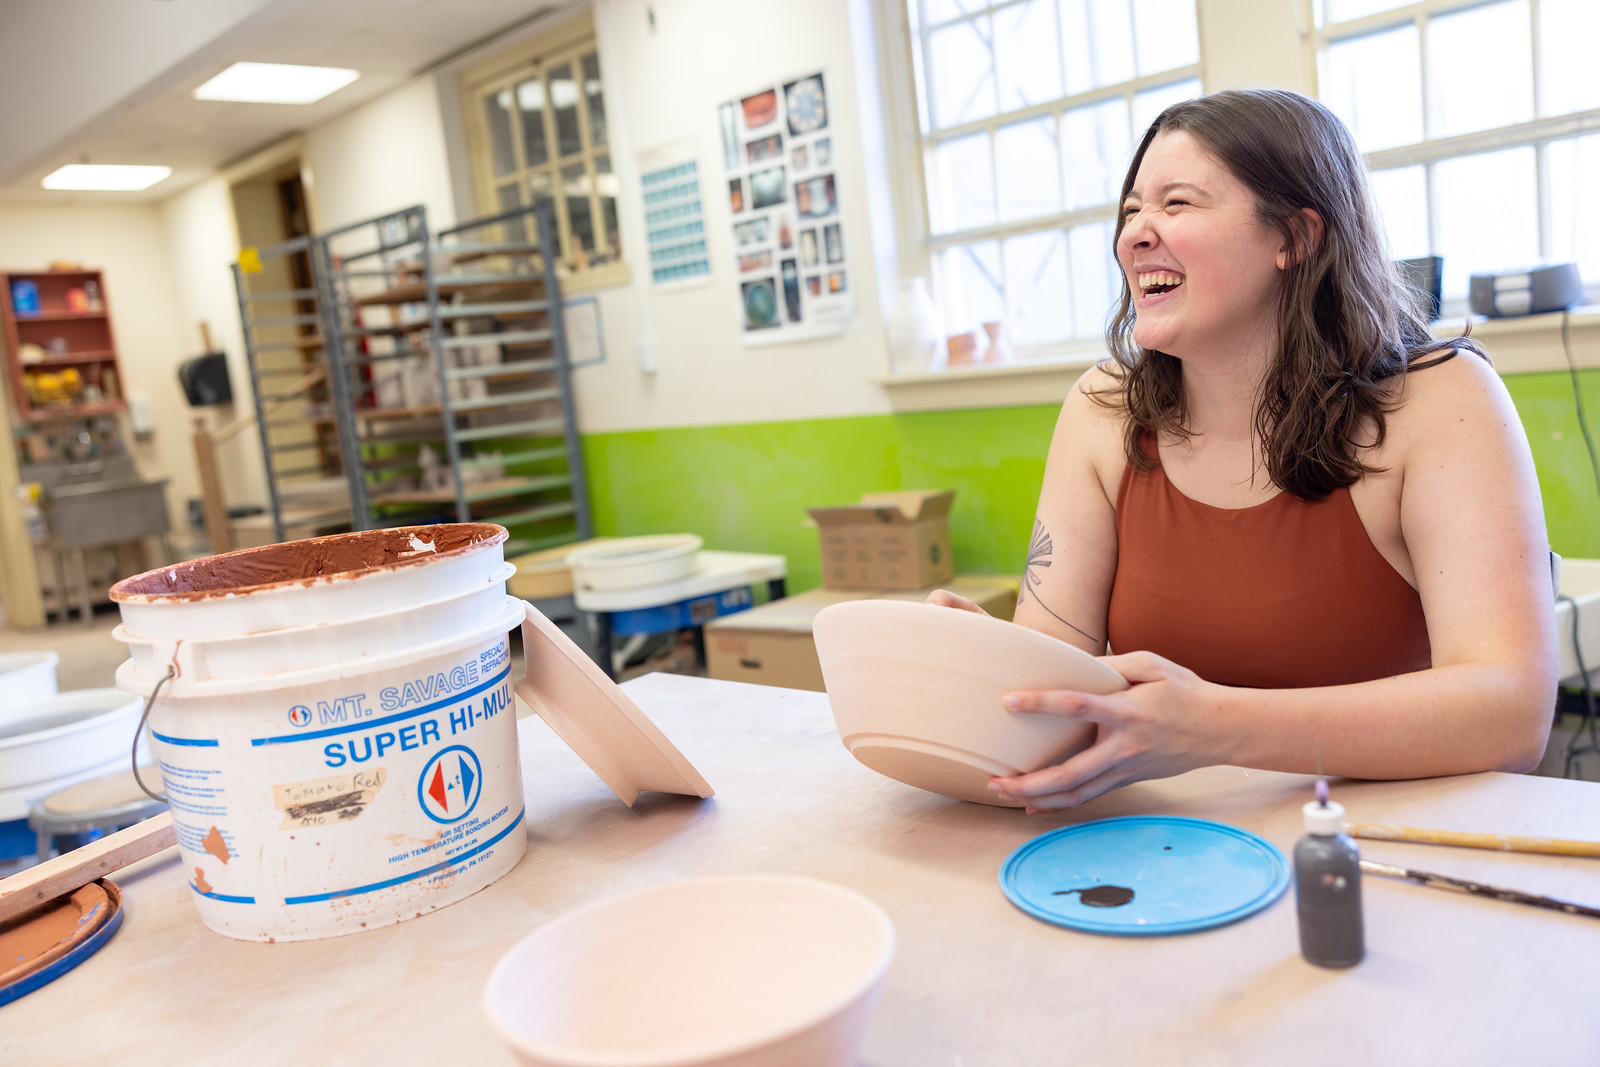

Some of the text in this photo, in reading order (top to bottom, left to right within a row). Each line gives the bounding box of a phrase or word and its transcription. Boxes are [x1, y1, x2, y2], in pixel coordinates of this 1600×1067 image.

[317, 660, 479, 725] MT. SAVAGE
[324, 683, 512, 768] SUPER HI-MUL
[353, 771, 381, 790] Red
[388, 805, 509, 864] HIGH TEMPERATURE BONDING MORTAR
[440, 817, 479, 840] AIR SETTING
[469, 859, 477, 868] PA
